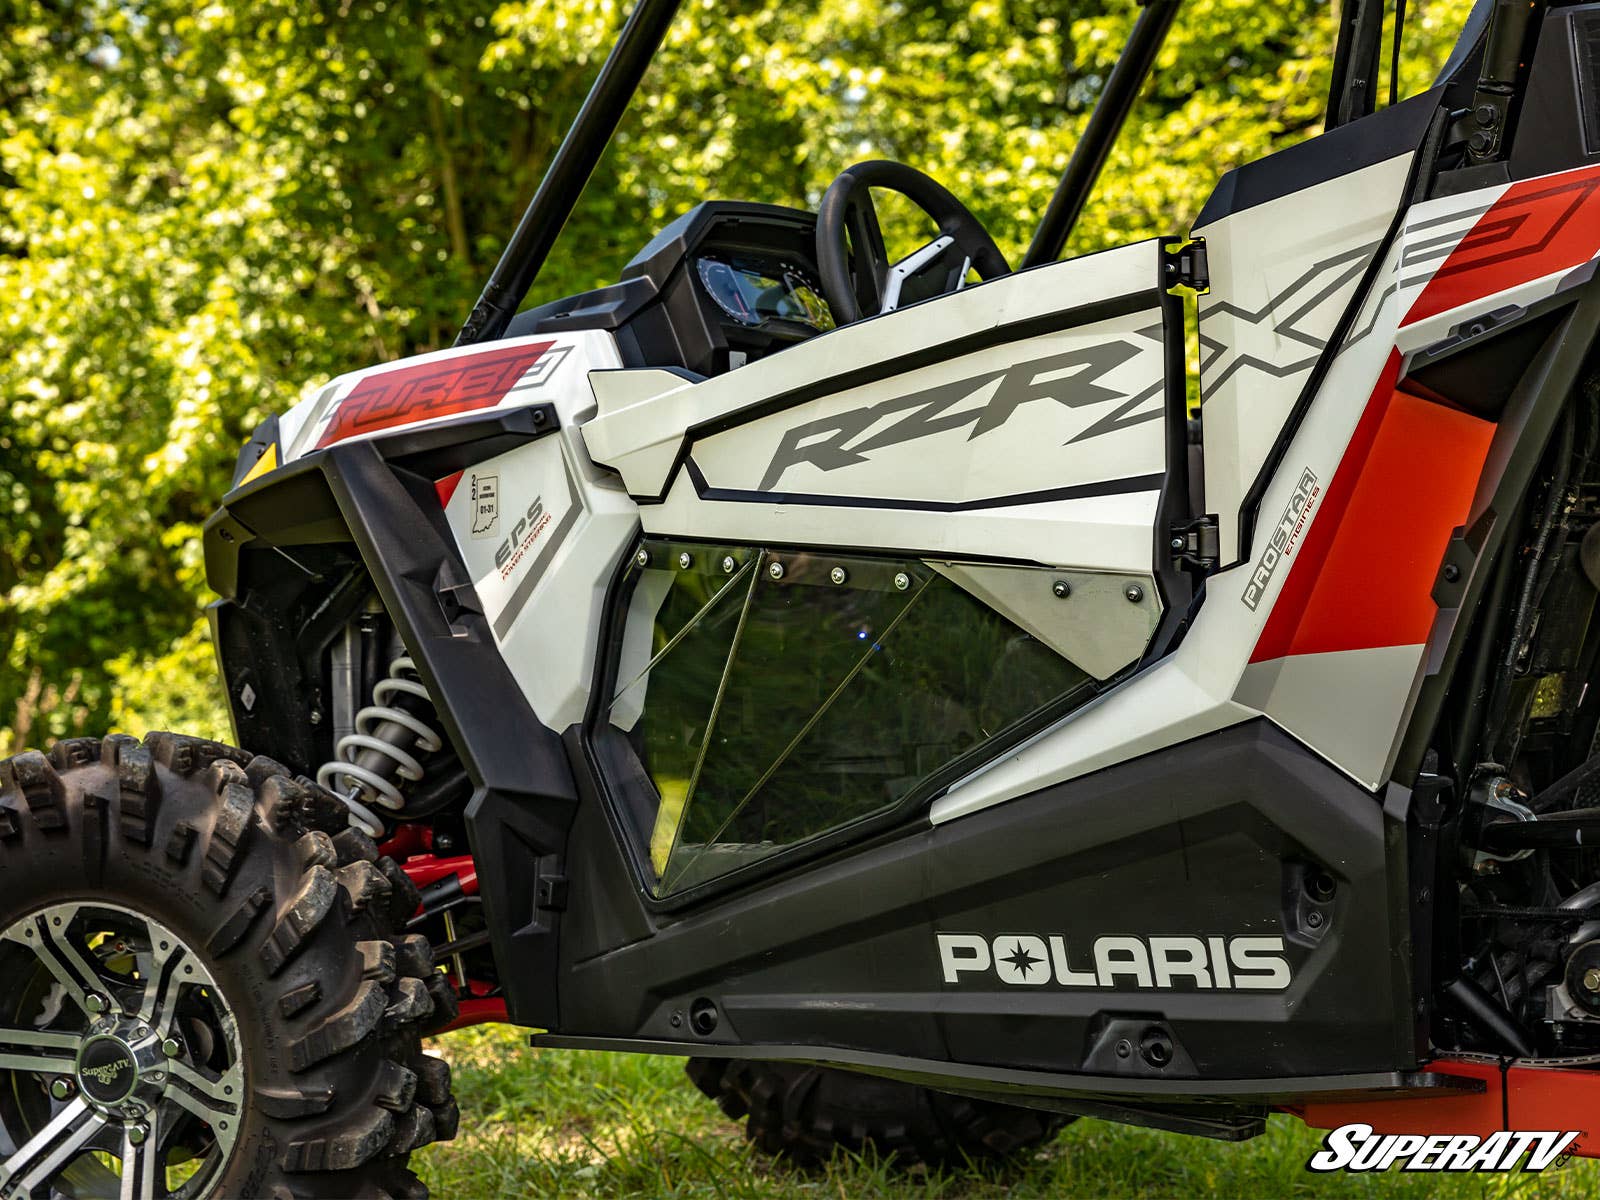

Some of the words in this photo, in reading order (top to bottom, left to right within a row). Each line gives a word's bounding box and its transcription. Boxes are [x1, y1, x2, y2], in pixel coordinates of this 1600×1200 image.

[320, 345, 576, 438] TURBO
[756, 340, 1143, 491] RZR
[495, 495, 543, 570] EPS
[1243, 469, 1317, 611] PROSTAR
[936, 933, 1292, 990] POLARIS
